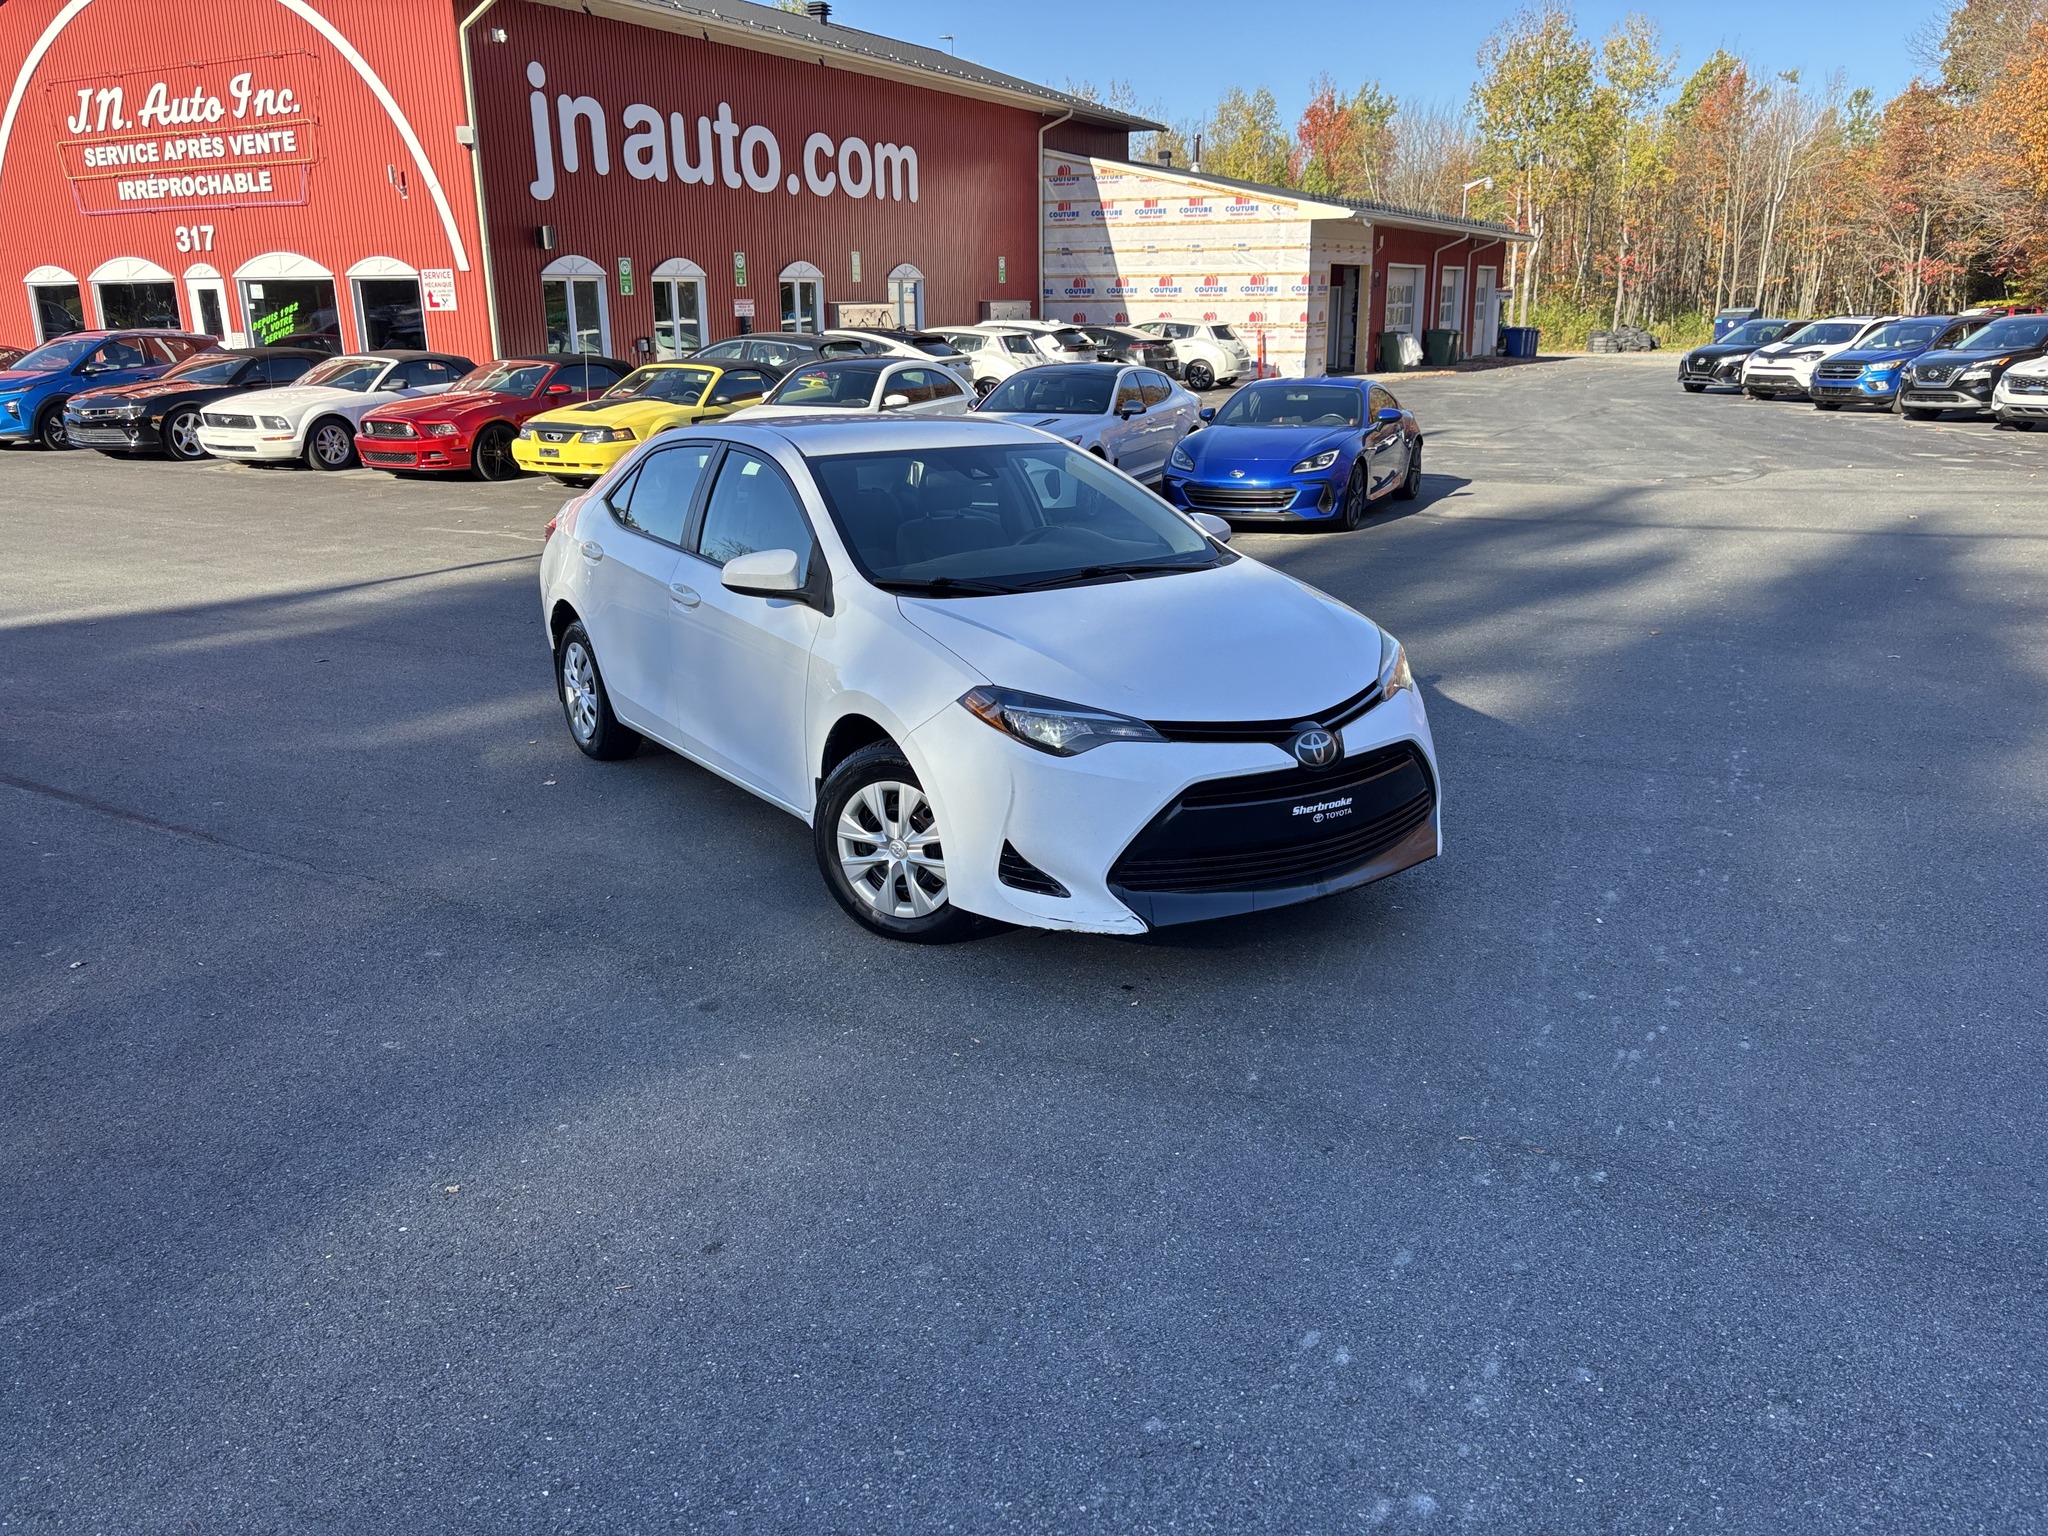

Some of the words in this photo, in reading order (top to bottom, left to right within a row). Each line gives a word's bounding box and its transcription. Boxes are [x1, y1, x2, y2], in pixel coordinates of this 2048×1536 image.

[67, 86, 133, 134] J.N.
[138, 82, 226, 128] Auto
[229, 72, 300, 119] Inc.
[84, 142, 159, 167] SERVICE
[164, 133, 225, 161] APRÈS
[229, 131, 297, 156] VENTE
[117, 171, 273, 201] IRRÉPROCHABLE
[1179, 206, 1212, 214] COUTURE
[175, 225, 215, 252] 317
[423, 271, 452, 280] SERVICE
[252, 312, 278, 331] DEPUIS
[280, 302, 299, 317] 1982
[270, 314, 293, 332] VOTRE
[264, 324, 295, 345] SERVICE
[1292, 797, 1353, 816] Sherbrooke
[1326, 807, 1352, 819] TOYOTA
